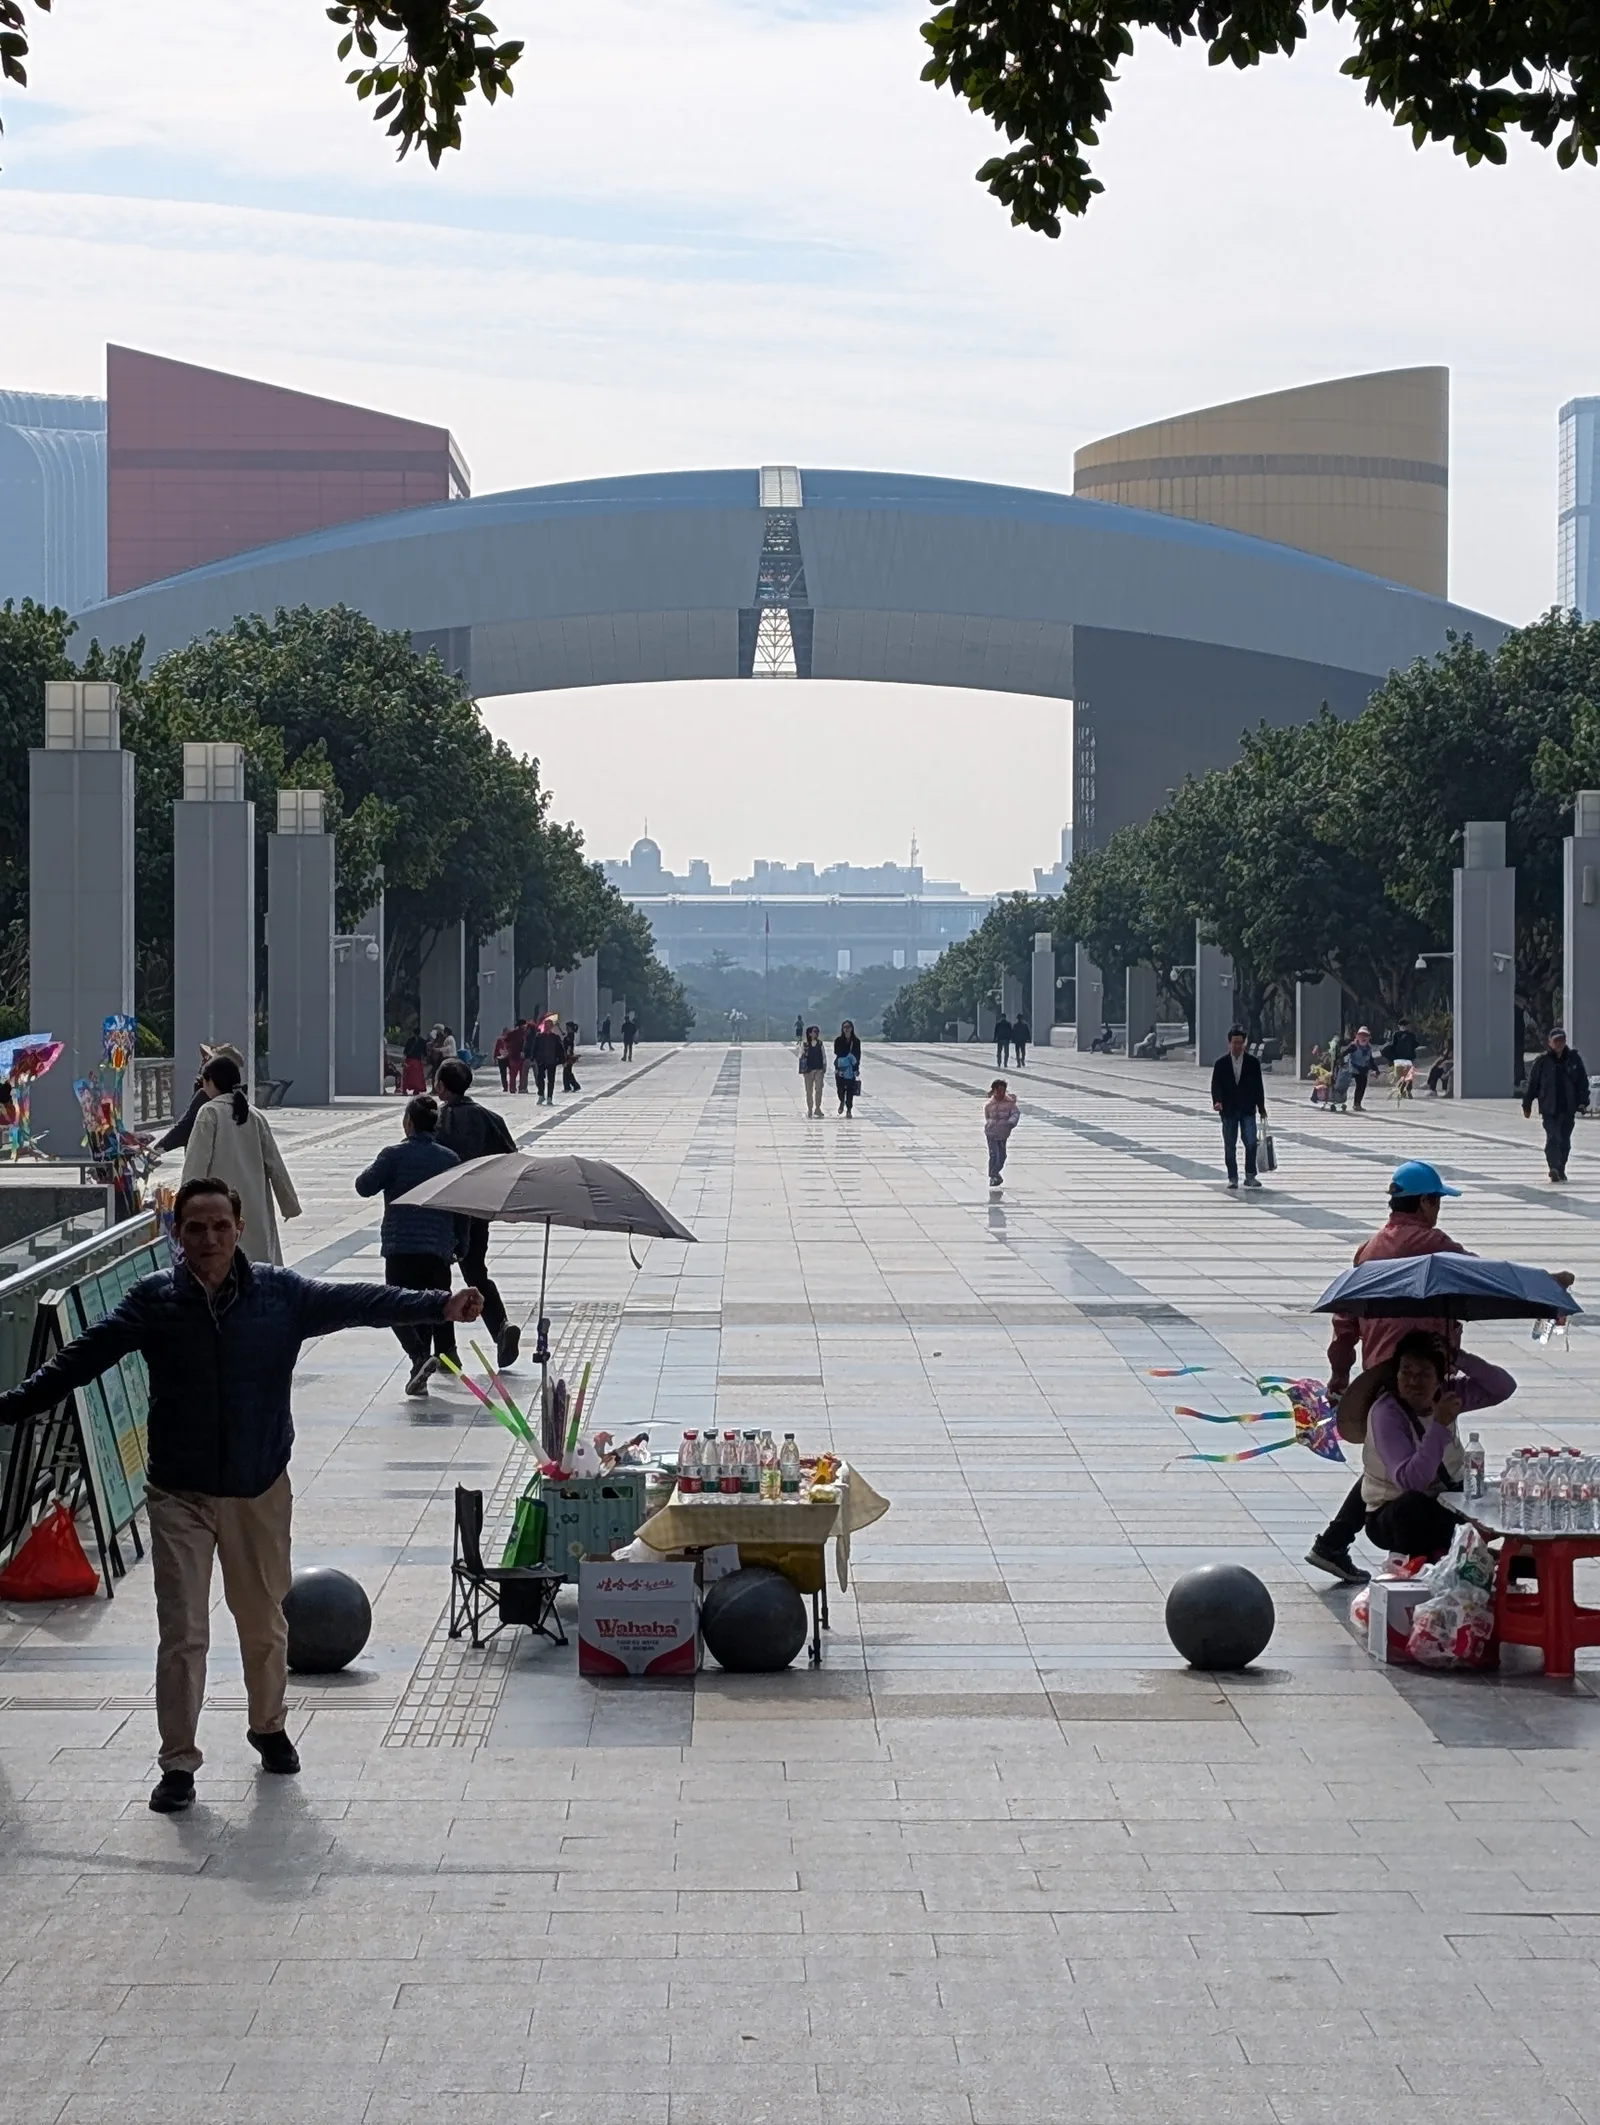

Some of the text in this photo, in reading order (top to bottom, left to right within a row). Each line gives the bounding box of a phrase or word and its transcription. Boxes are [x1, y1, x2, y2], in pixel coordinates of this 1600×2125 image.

[596, 1577, 642, 1592] 娃哈哈
[595, 1618, 678, 1638] Wahaha
